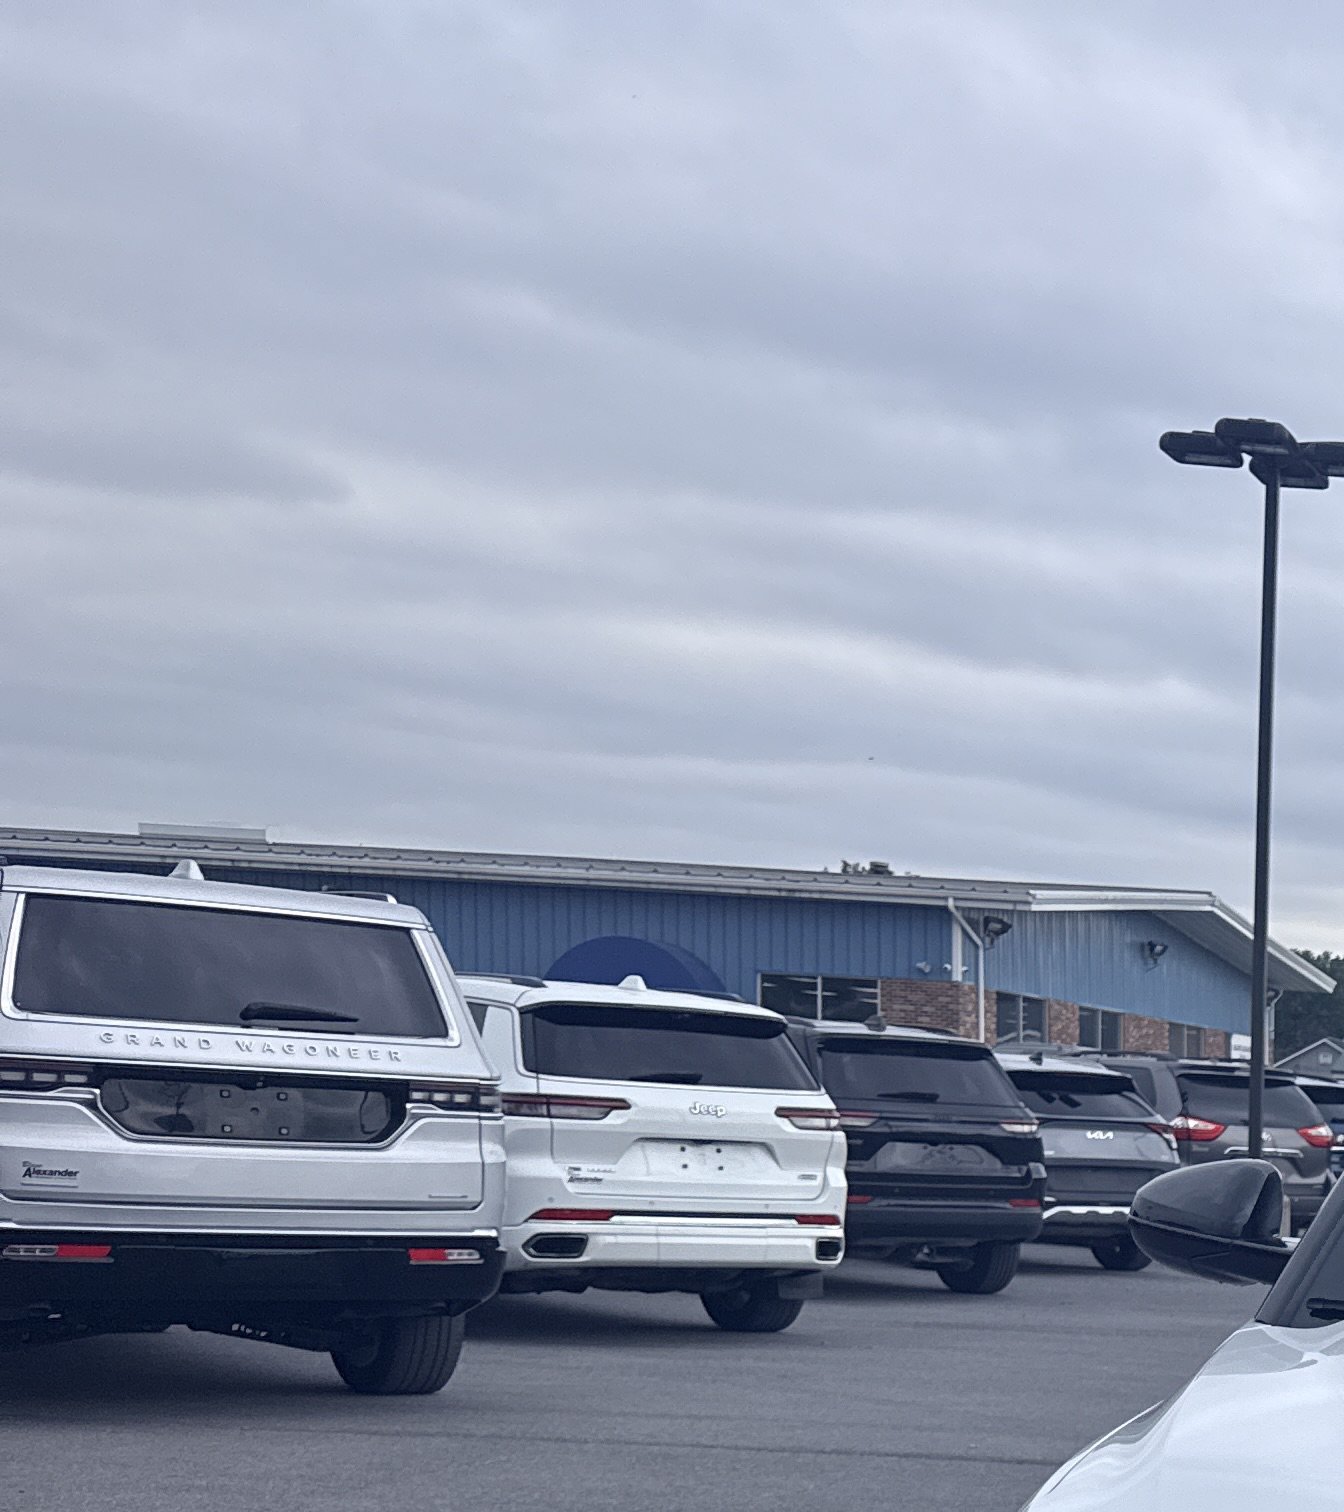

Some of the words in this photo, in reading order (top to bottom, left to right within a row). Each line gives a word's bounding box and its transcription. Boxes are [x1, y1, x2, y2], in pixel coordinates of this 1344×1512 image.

[99, 1031, 212, 1051] GRAND
[235, 1039, 402, 1063] WAGONEER
[689, 1101, 727, 1119] Jeep
[22, 1166, 80, 1178] Alexander
